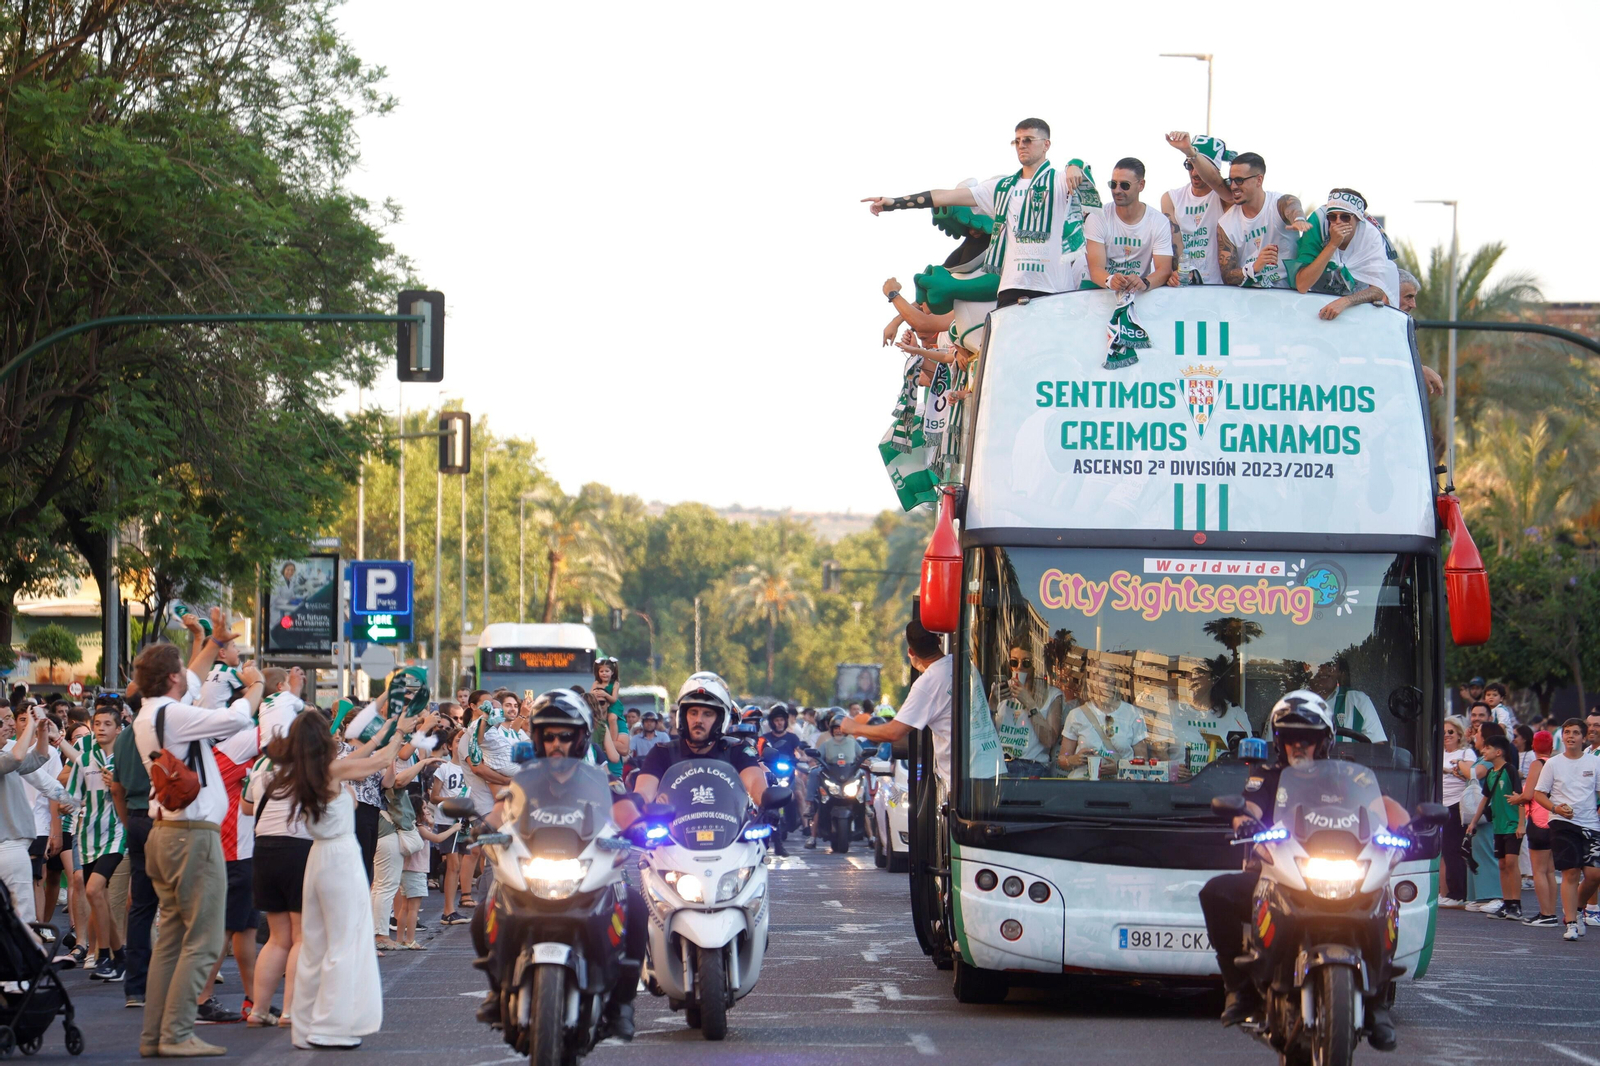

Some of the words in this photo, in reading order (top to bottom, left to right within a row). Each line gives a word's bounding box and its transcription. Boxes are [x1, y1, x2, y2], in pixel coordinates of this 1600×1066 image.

[1036, 380, 1177, 410] SENTIMOS
[1225, 383, 1376, 413] LUCHAMOS
[1060, 420, 1187, 451] CREIMOS
[1219, 423, 1361, 455] GANAMOS
[1073, 459, 1143, 476] ASCENSO
[1147, 459, 1166, 476] 2ª
[1170, 457, 1237, 477] DIVISIÓN
[1242, 461, 1335, 479] 2023/2024
[1155, 559, 1282, 575] Worldwide
[366, 569, 397, 610] P
[1039, 568, 1109, 617] City
[1110, 570, 1316, 625] Sightseeing
[367, 614, 393, 625] LIBRE
[1000, 724, 1029, 736] ENTIMOS
[706, 767, 736, 789] LOCAL
[1131, 930, 1174, 949] 9812
